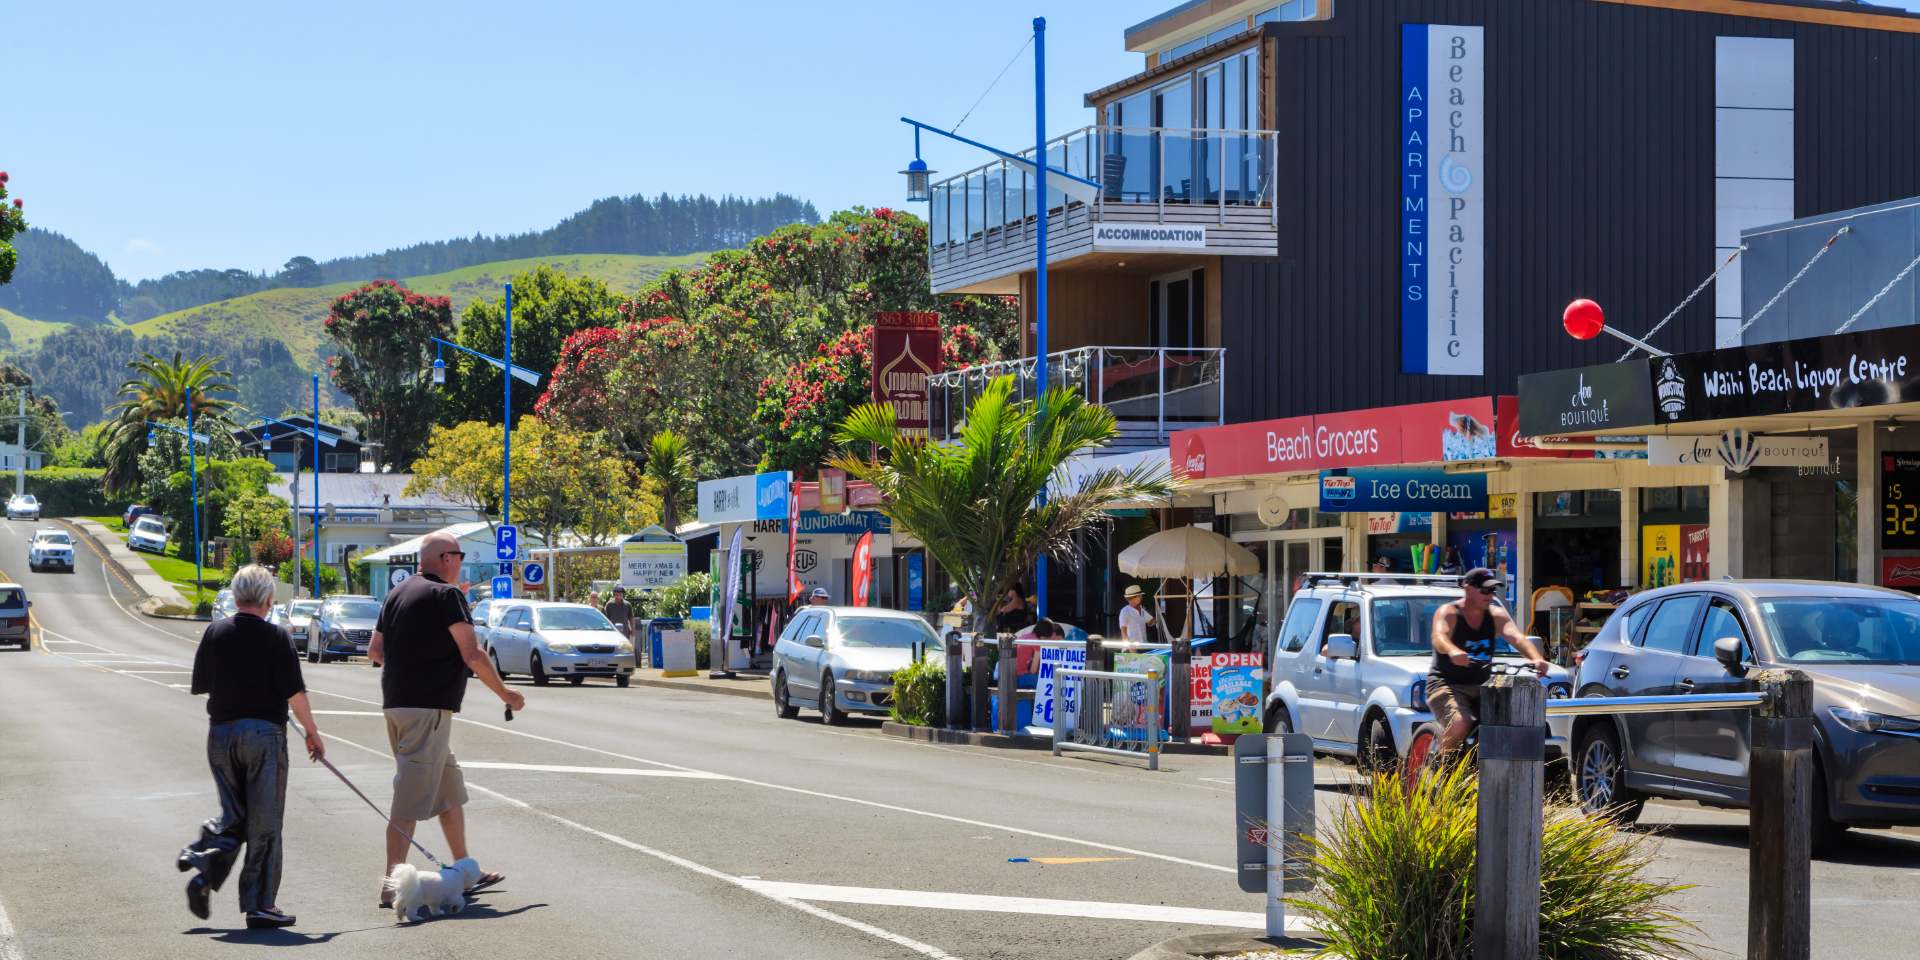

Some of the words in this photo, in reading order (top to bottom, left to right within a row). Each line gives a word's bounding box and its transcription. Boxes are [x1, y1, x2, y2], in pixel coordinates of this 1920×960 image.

[1449, 36, 1466, 153] Beach
[1406, 86, 1424, 301] APARTMENTS
[1097, 228, 1202, 241] ACCOMMODATION
[1447, 197, 1466, 358] Pacific
[888, 371, 926, 391] INDIAN
[1704, 370, 1744, 398] Waihi
[1749, 362, 1793, 395] Beach
[1795, 360, 1842, 399] Liquor
[1850, 353, 1907, 384] Centre
[1571, 373, 1592, 407] Ava
[1657, 381, 1685, 401] WOODSTOCK
[893, 400, 928, 420] ROMA
[1267, 427, 1312, 462] Beach
[1315, 425, 1379, 458] Grocers
[1679, 437, 1712, 464] Ava
[1371, 480, 1401, 499] Ice
[1406, 479, 1472, 499] Cream
[797, 513, 868, 531] AUNDROMAT
[502, 530, 512, 542] P
[628, 562, 652, 570] MERRY
[655, 562, 673, 570] XMAS
[796, 552, 816, 571] EUS
[1041, 648, 1064, 660] DAIRY
[1066, 649, 1086, 662] DALE
[1216, 654, 1263, 666] OPEN
